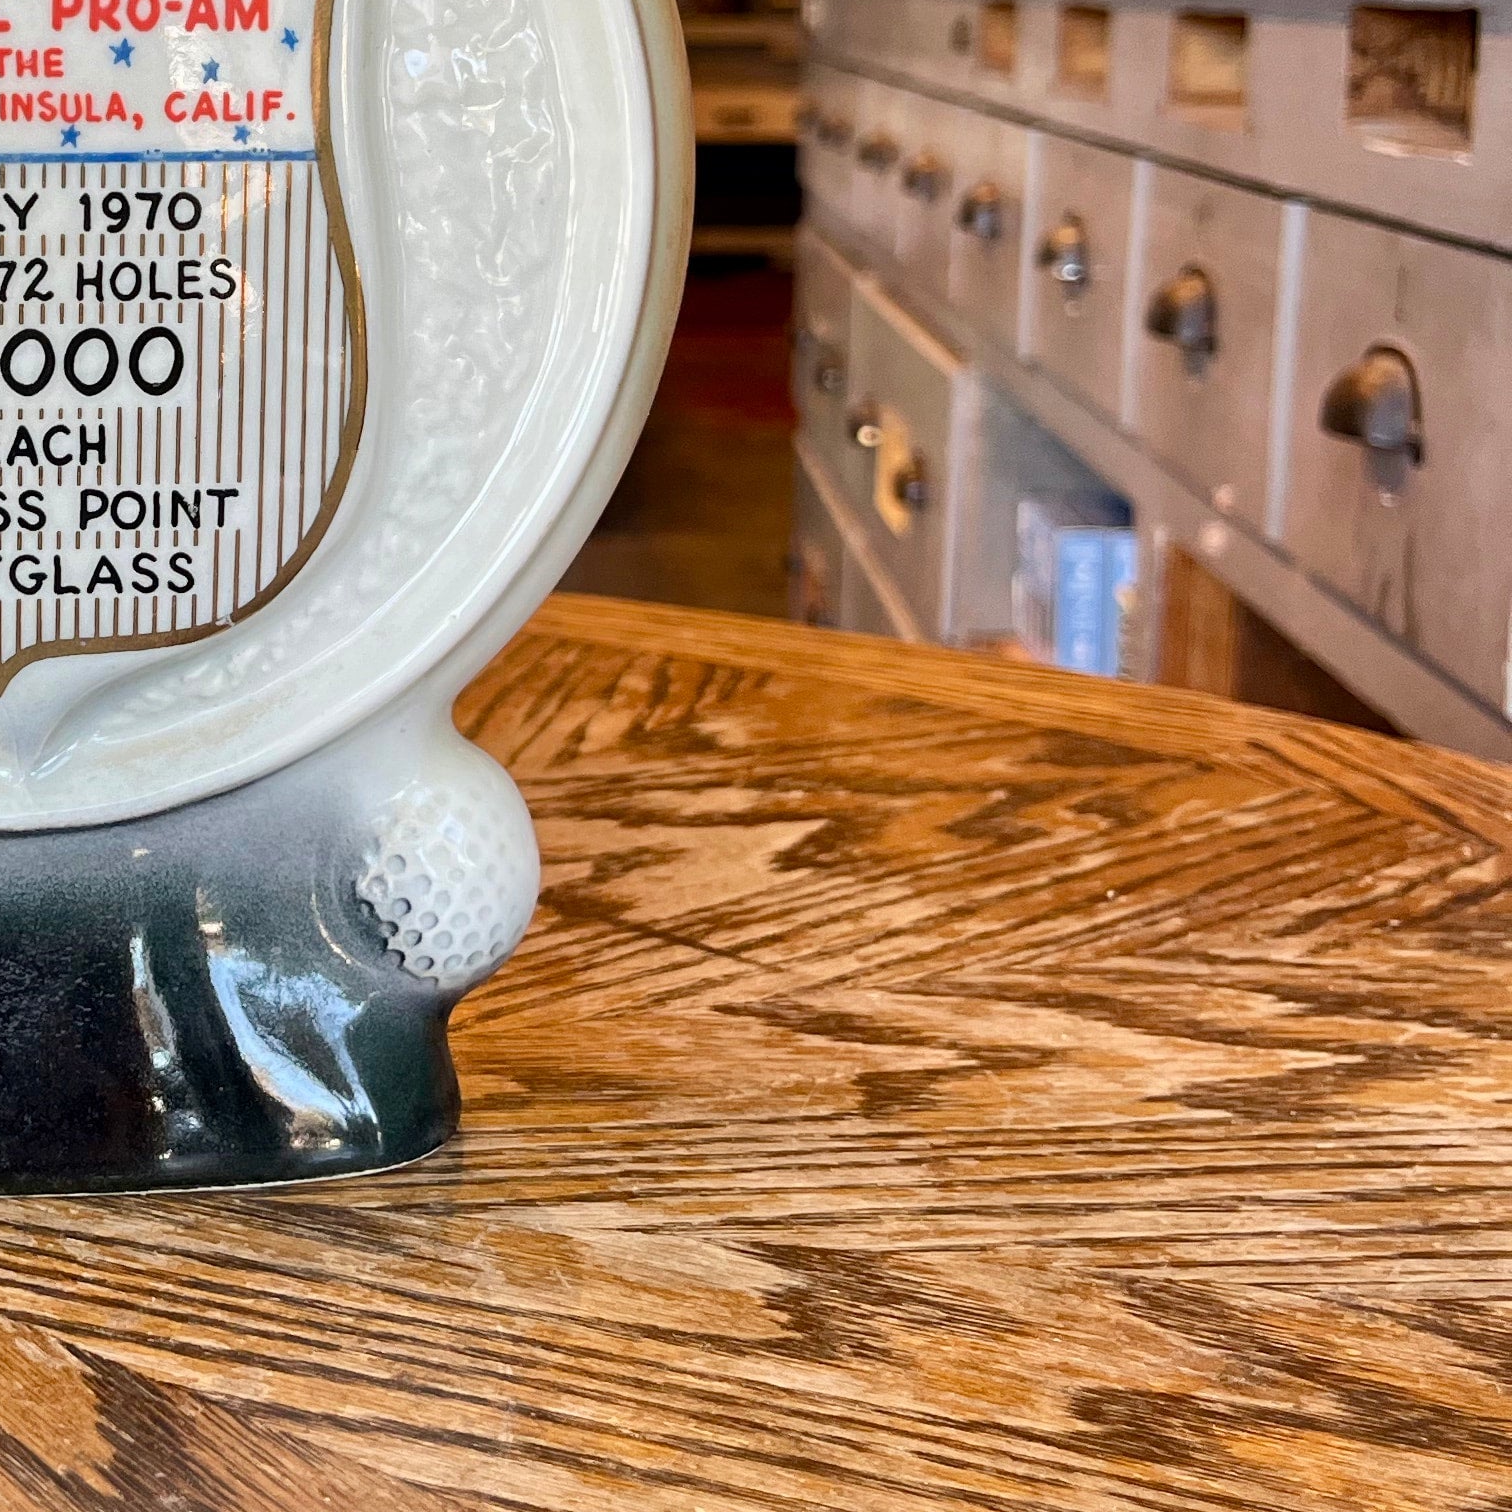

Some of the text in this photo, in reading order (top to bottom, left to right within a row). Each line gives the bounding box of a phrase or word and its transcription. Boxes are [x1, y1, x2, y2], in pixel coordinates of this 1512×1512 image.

[165, 91, 294, 122] CALIF.
[80, 192, 202, 233] 1970
[76, 259, 236, 302] HOLES
[80, 489, 238, 530] POINT
